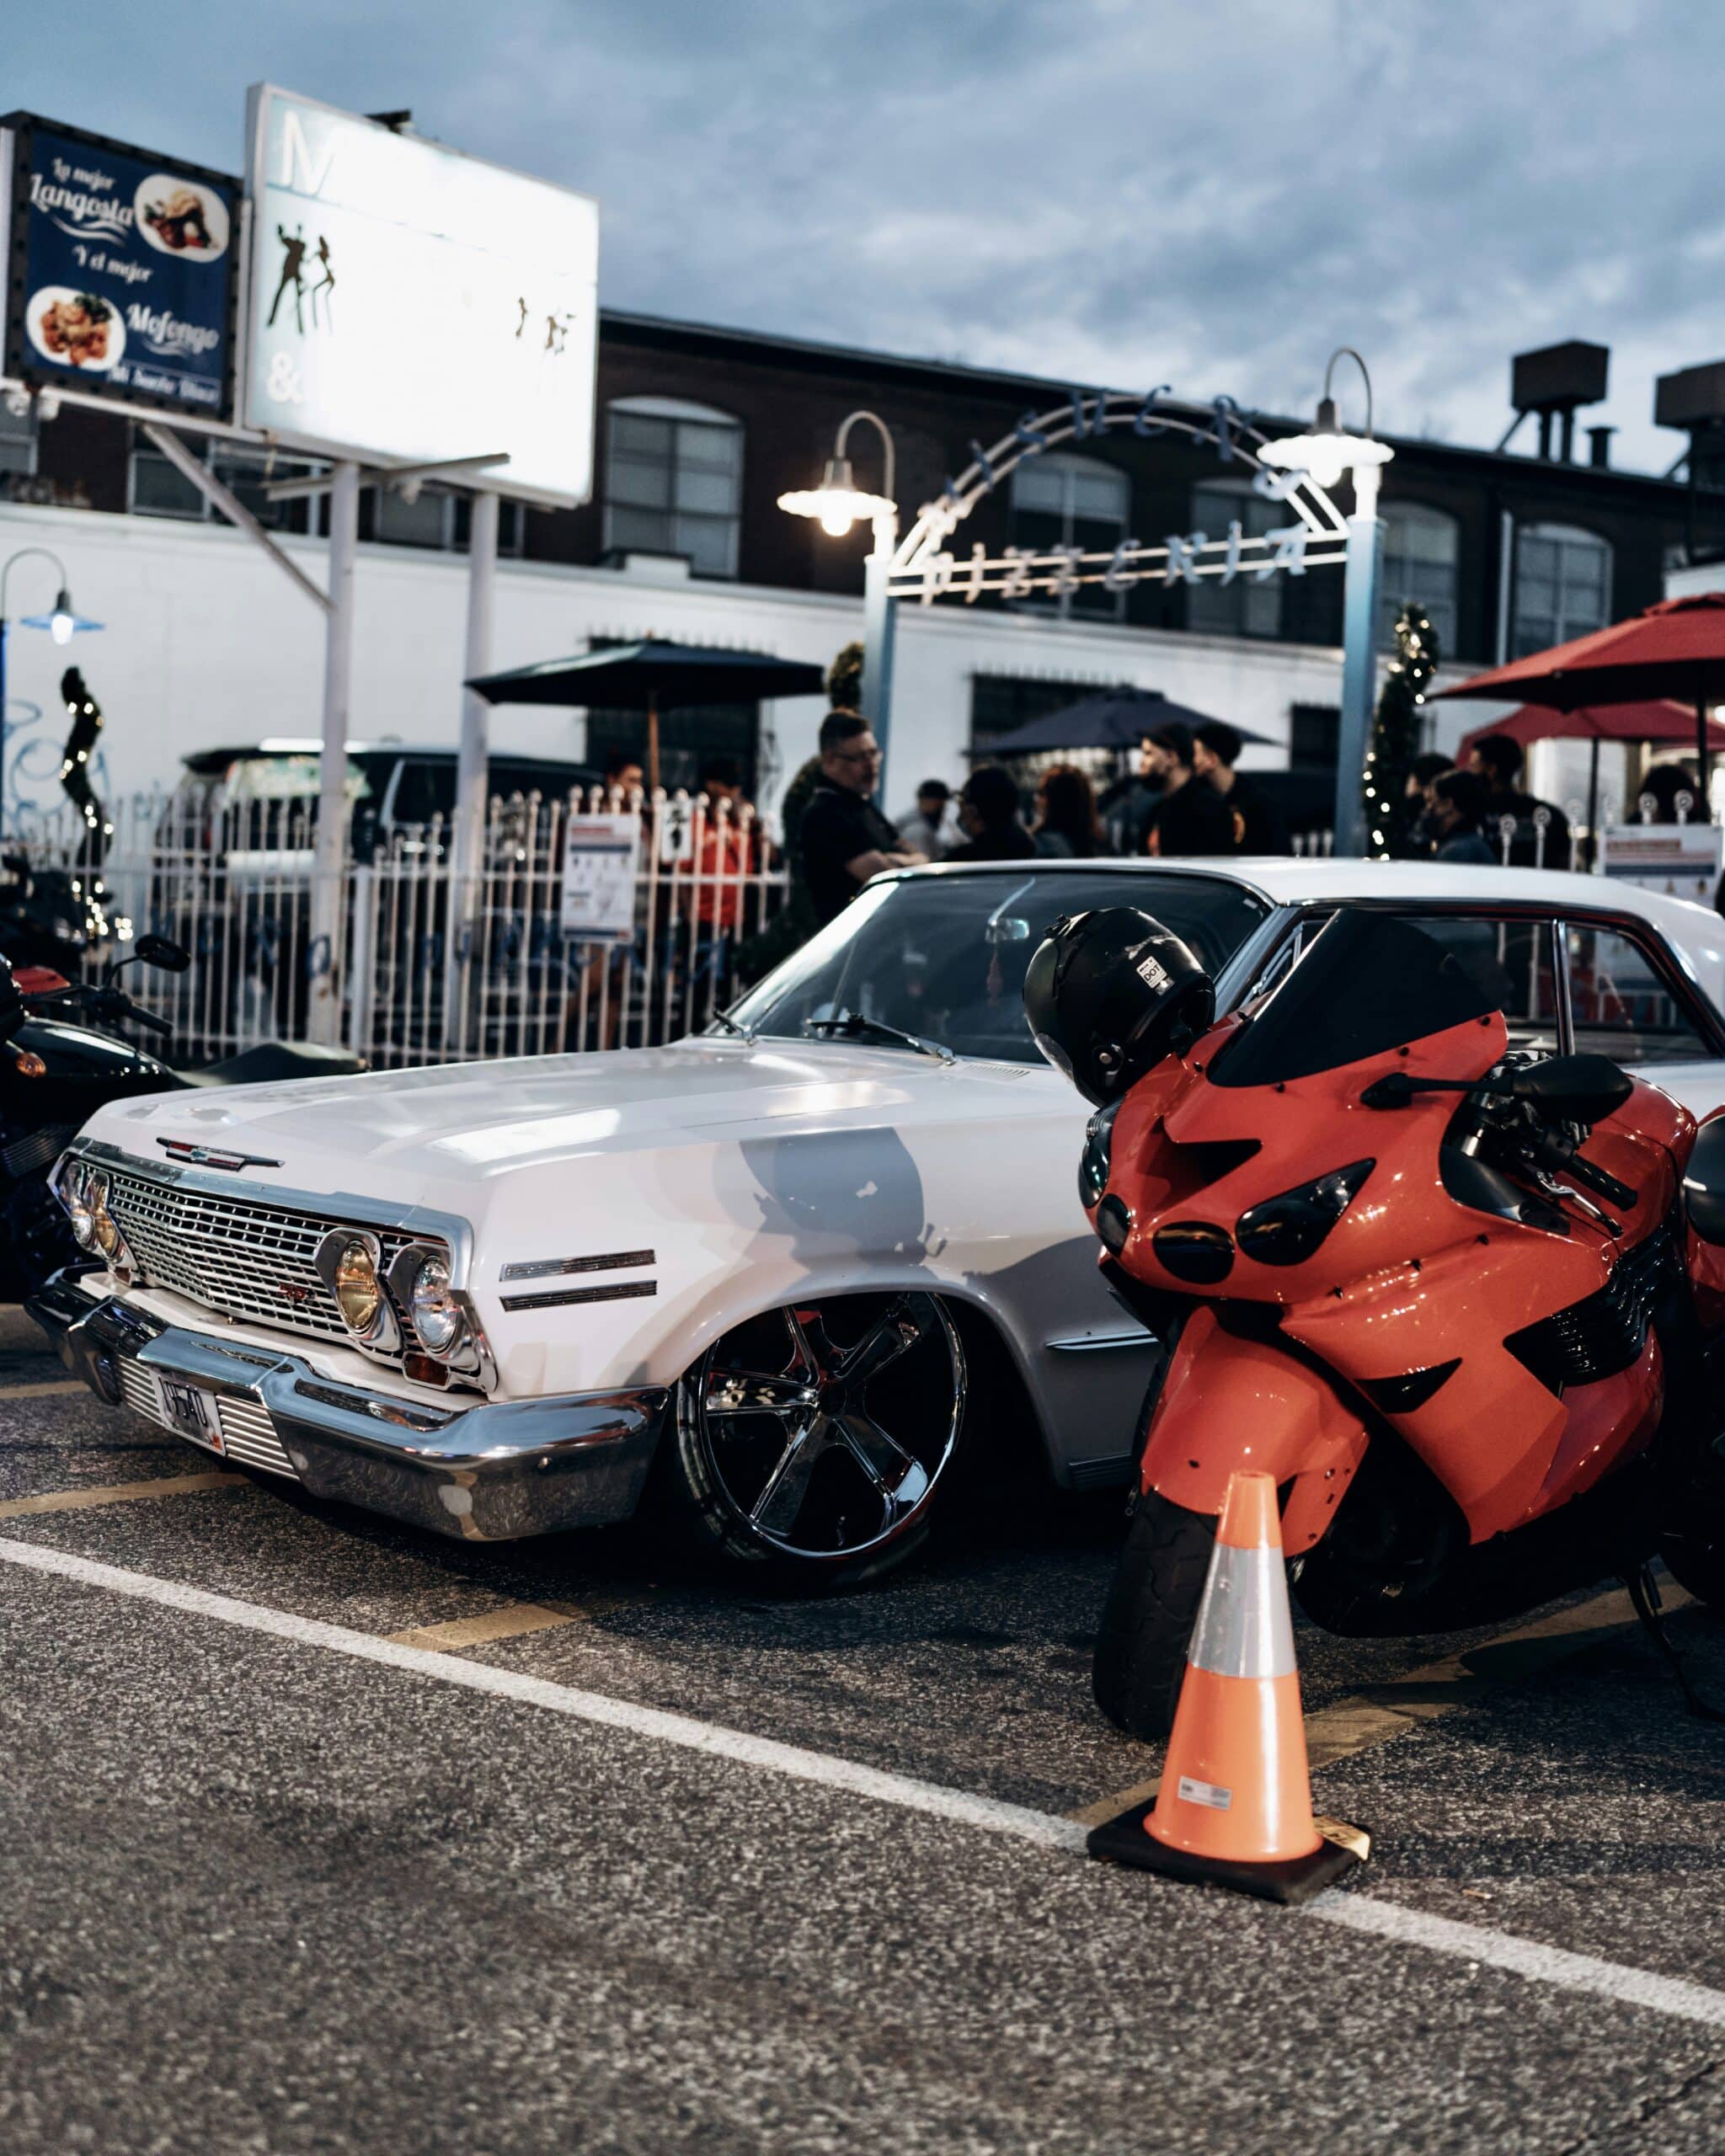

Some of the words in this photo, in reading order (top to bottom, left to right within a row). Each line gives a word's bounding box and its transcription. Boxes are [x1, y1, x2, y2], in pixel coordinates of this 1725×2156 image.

[73, 167, 116, 192] mejor
[30, 173, 134, 227] Langosta
[106, 259, 153, 286] mejor
[126, 303, 220, 355] Mofongo
[921, 520, 1312, 606] PIZZERIA
[1144, 963, 1161, 981] DOT
